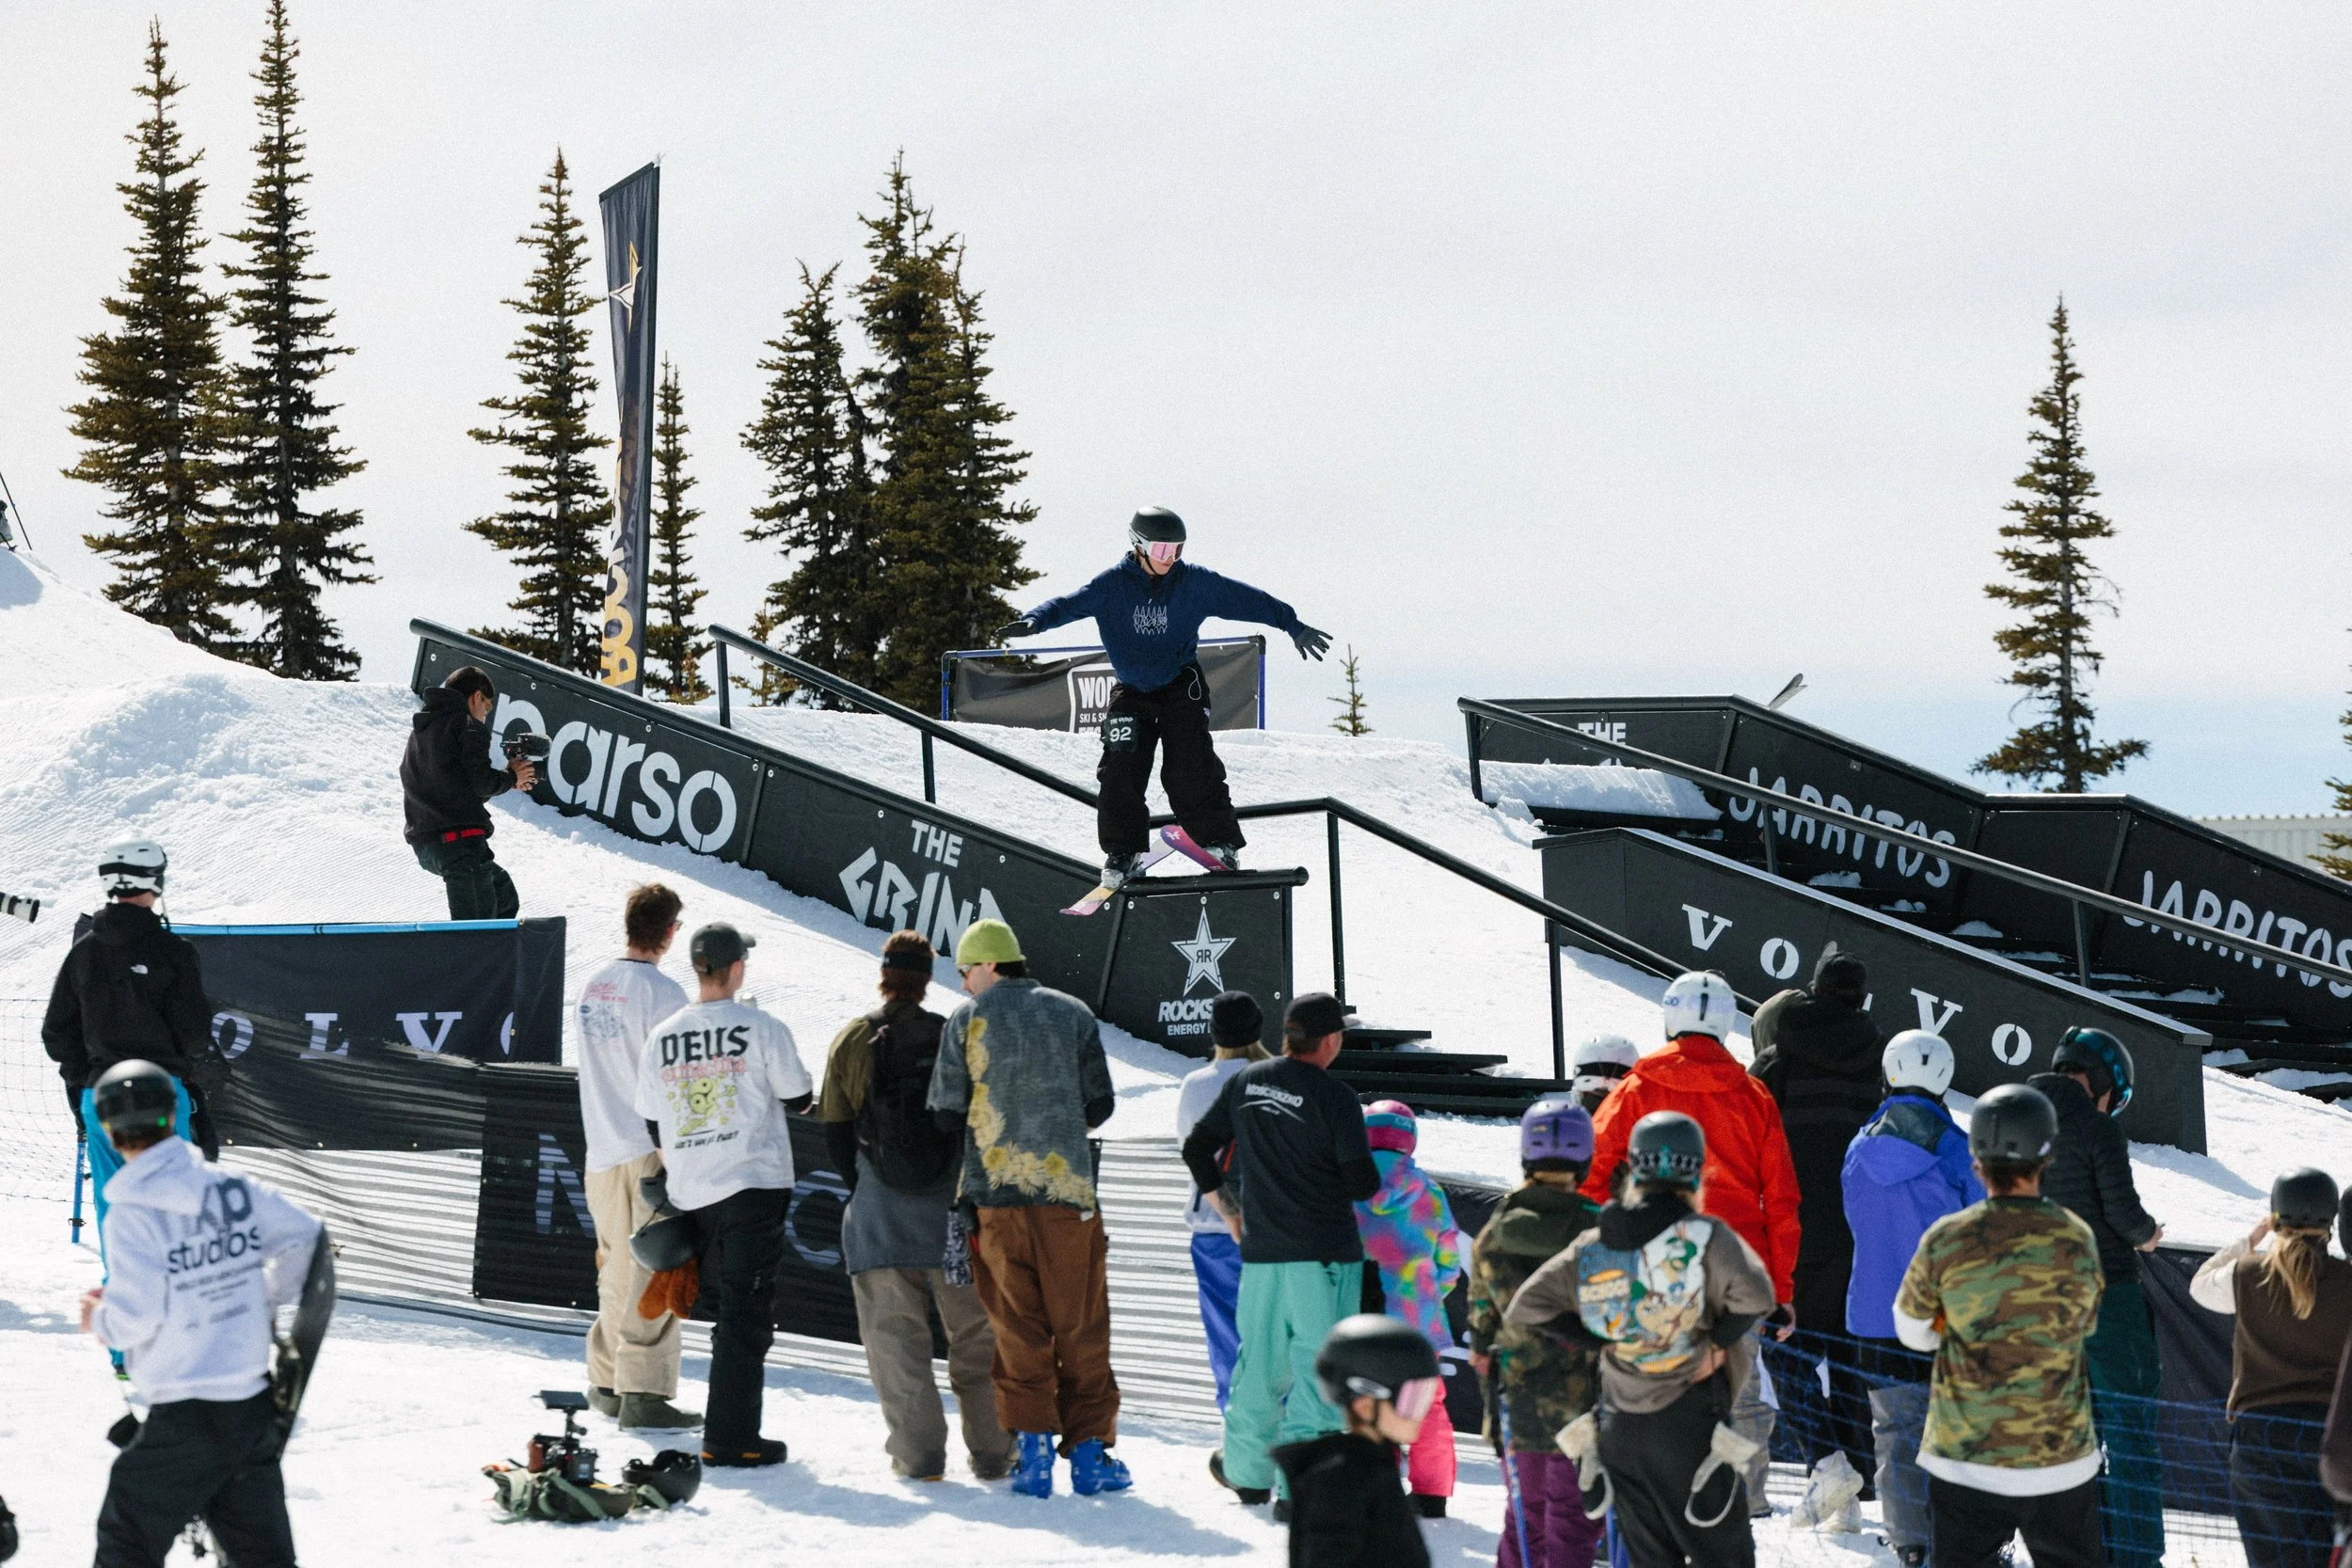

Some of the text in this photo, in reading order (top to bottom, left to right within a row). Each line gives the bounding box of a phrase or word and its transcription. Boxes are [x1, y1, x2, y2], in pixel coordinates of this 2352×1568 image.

[1079, 712, 1107, 723] SKI & SN
[1109, 726, 1132, 742] 92
[1578, 722, 1627, 745] THE
[911, 819, 963, 868] THE
[1729, 767, 1956, 889] JARRITOS
[1681, 903, 2032, 1067] VOVO
[1157, 998, 1214, 1022] ROCKS
[212, 1011, 515, 1061] OLV
[1168, 1022, 1206, 1036] ENERGY
[660, 1025, 751, 1068] DEUS
